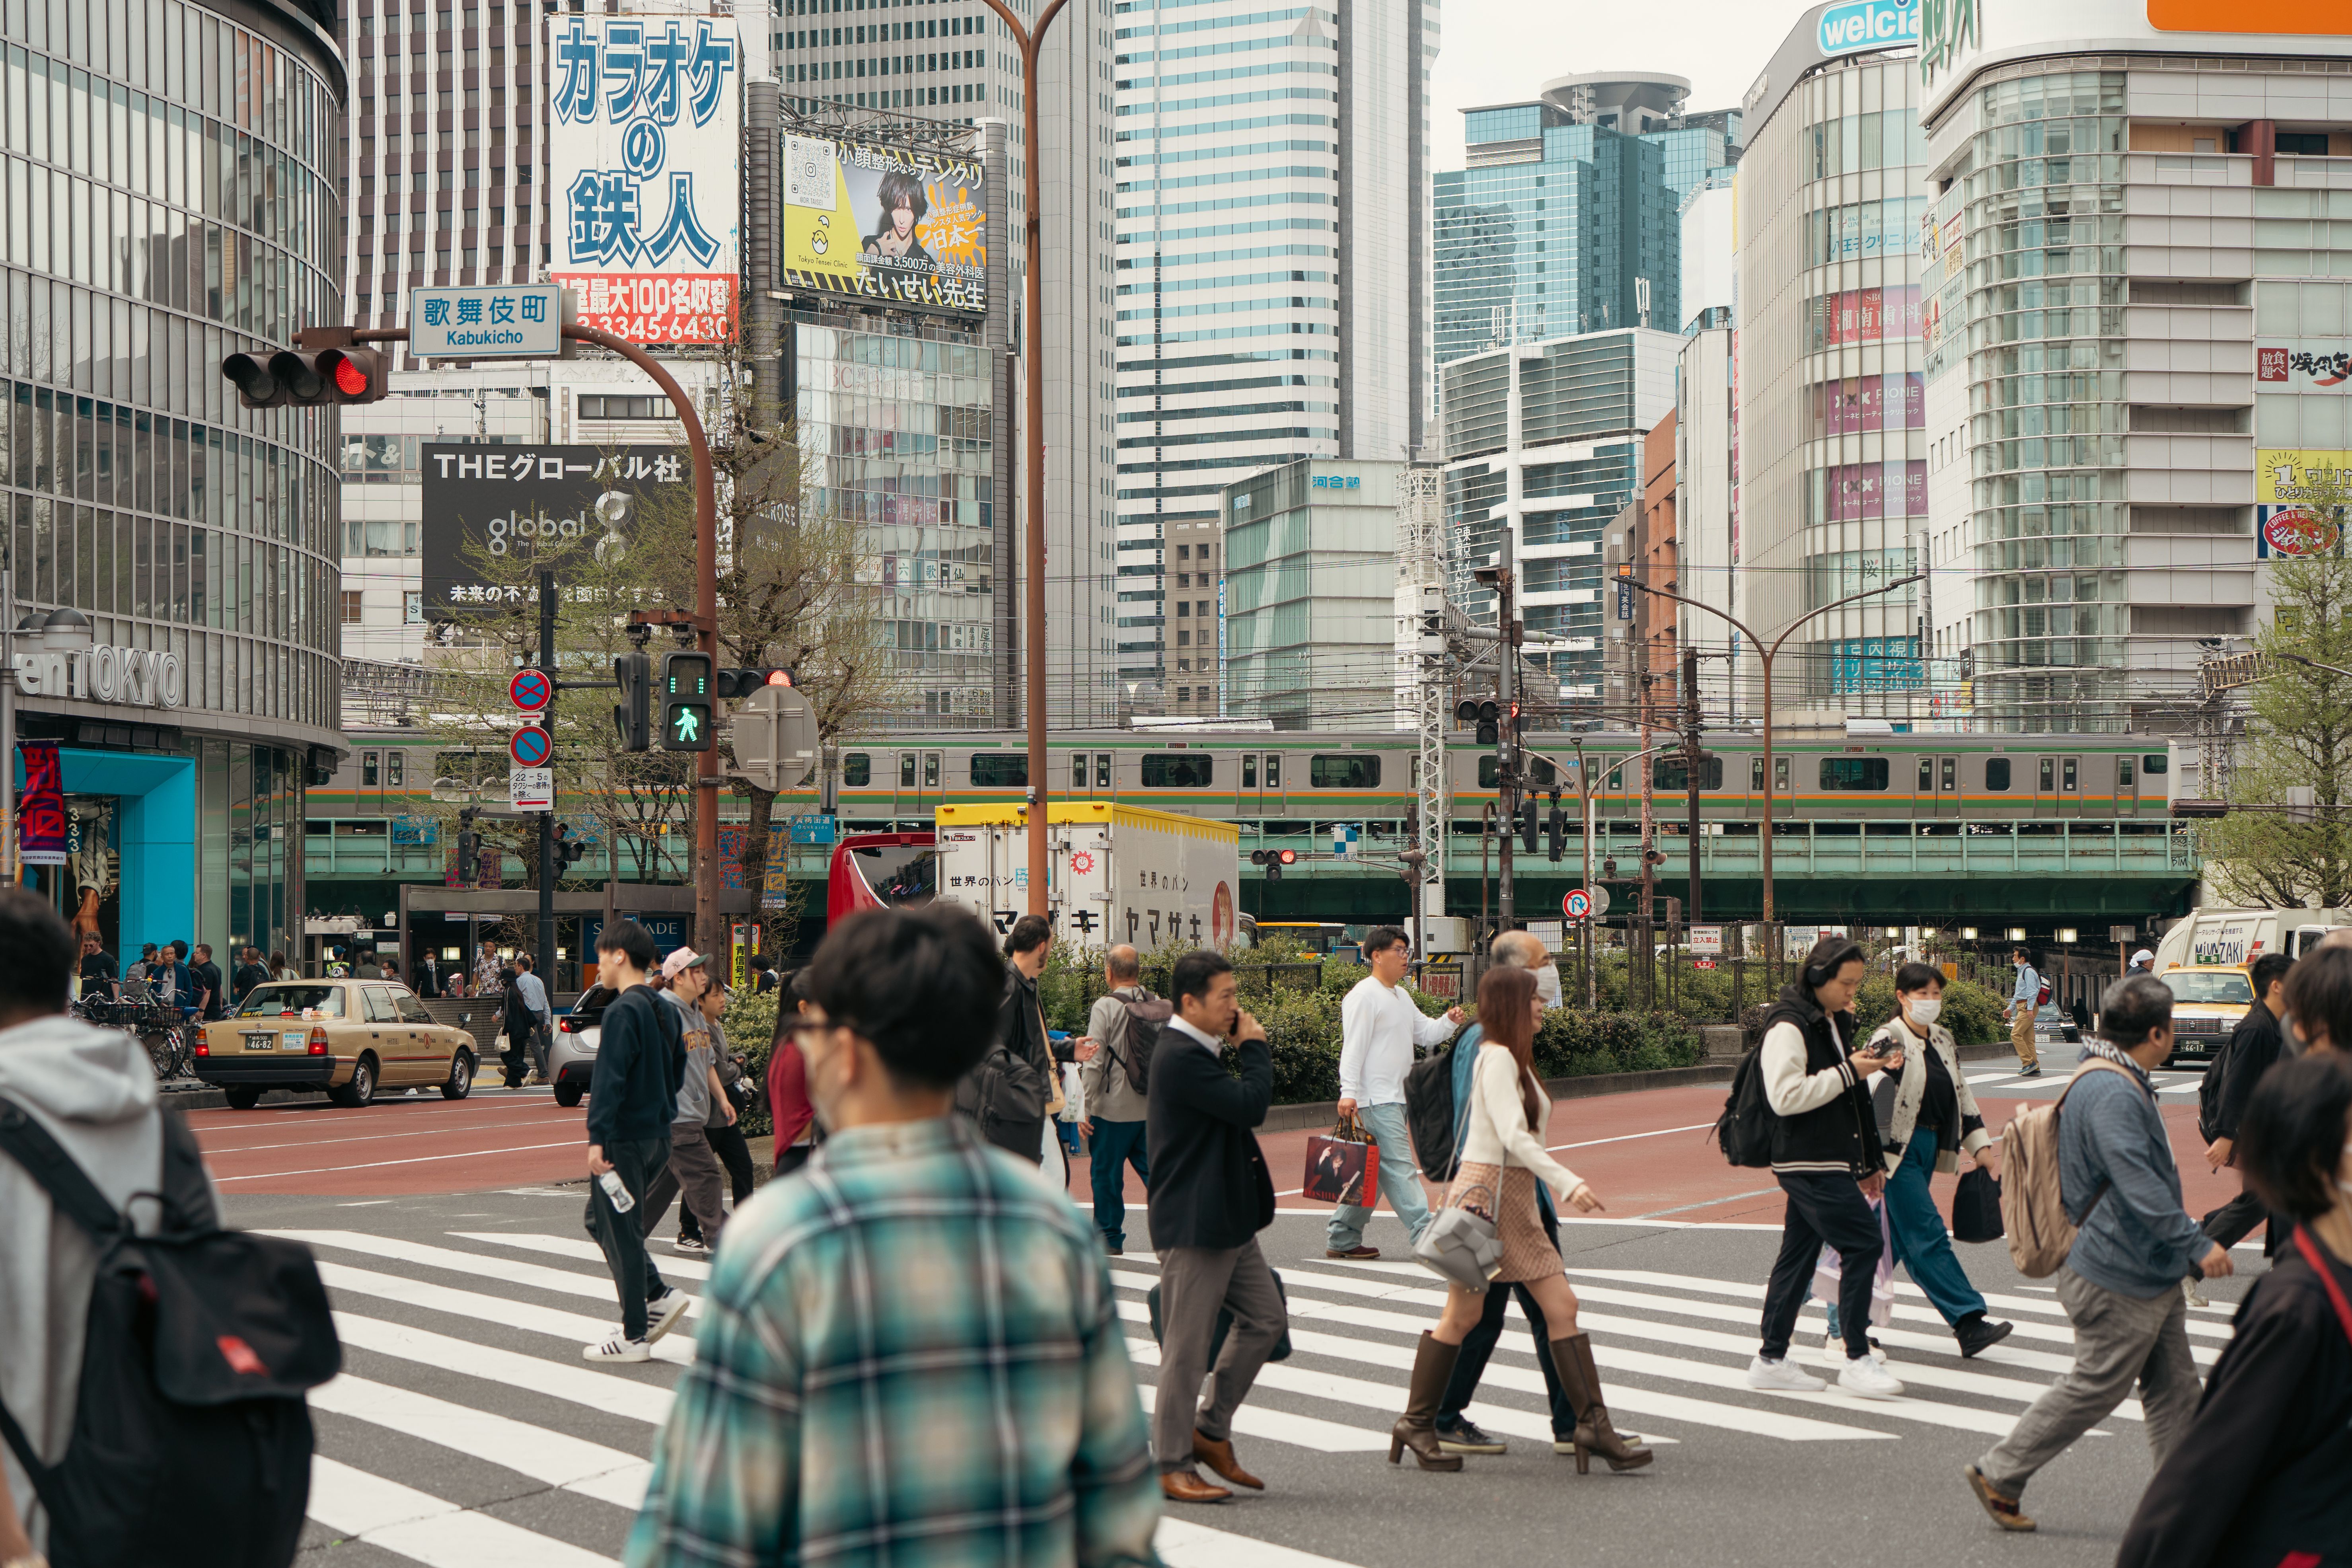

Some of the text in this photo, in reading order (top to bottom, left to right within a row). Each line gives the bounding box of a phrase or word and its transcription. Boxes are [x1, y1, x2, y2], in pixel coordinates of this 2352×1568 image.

[553, 18, 734, 129] カラオケ
[621, 115, 666, 182] の
[837, 147, 982, 190] 小顔整形ならテンクリ
[800, 197, 823, 206] @DR.TAISEI
[925, 202, 974, 220] 小顔整形症例数
[566, 169, 721, 269] 鉄人
[927, 210, 983, 228] インスタ人気ランク
[934, 226, 984, 250] 日本一
[798, 255, 814, 264] Tokyo
[856, 266, 986, 308] たいせい先生
[424, 295, 548, 326] 歌舞伎町
[1837, 302, 1921, 331] 湘南歯科
[447, 329, 523, 345] Kabukicho
[433, 453, 682, 482] THEグローバル社
[1312, 476, 1360, 489] 河合塾
[2268, 513, 2289, 528] COFFEE
[489, 510, 585, 556] global
[450, 585, 664, 602] 未来の不動を面白くする
[954, 626, 962, 647] 個室
[68, 643, 182, 709] TOKYO
[950, 875, 1014, 887] 世界のパン
[1140, 870, 1188, 893] 世界のパン
[1125, 906, 1201, 948] ヤマザキ
[251, 1040, 272, 1049] 46-82
